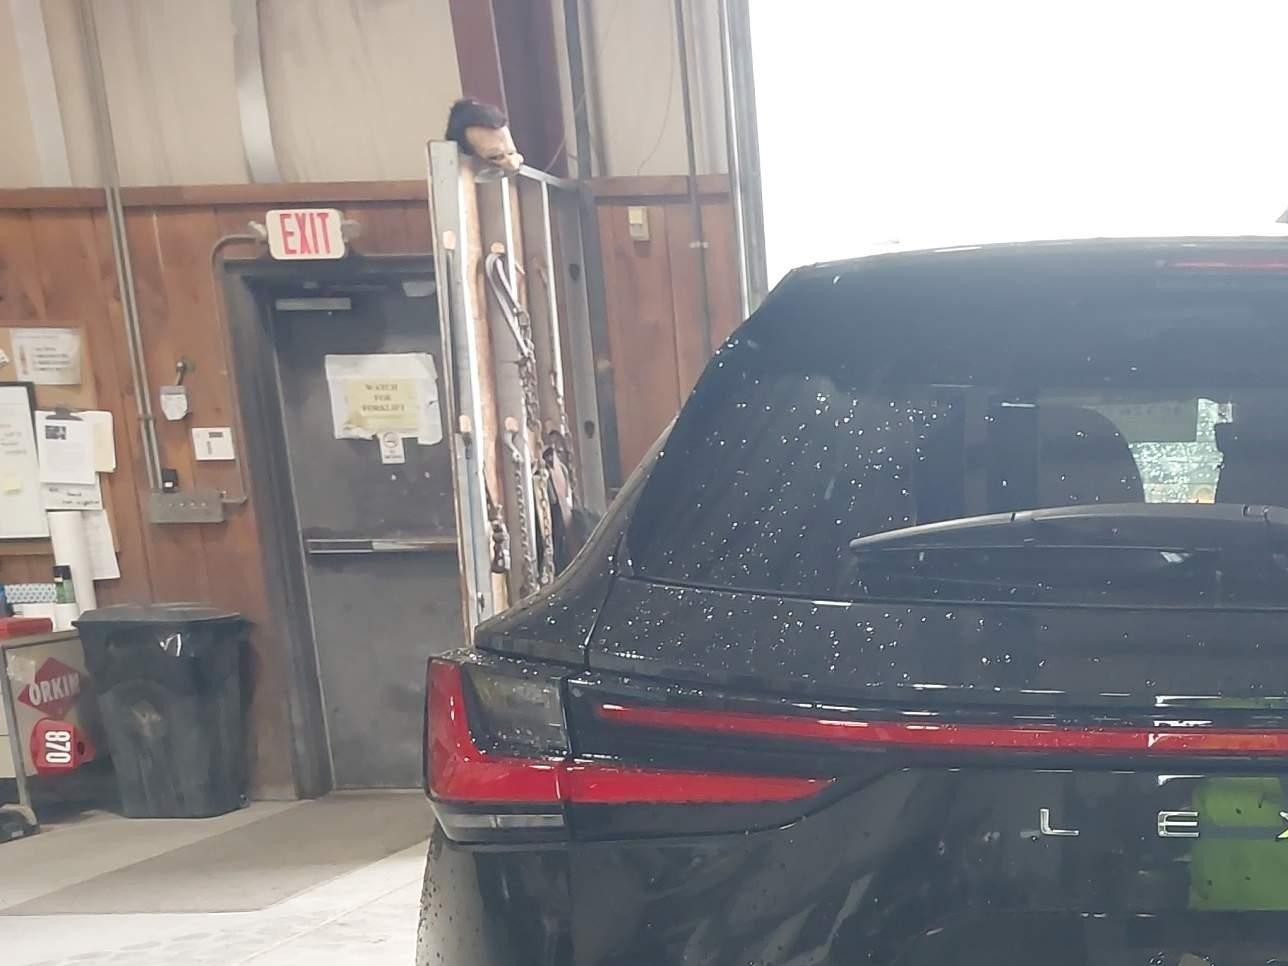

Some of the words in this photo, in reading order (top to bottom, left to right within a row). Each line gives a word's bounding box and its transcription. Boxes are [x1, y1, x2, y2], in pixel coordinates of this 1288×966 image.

[280, 212, 331, 254] EXIT
[28, 672, 81, 706] ORKIN
[45, 731, 71, 763] 870
